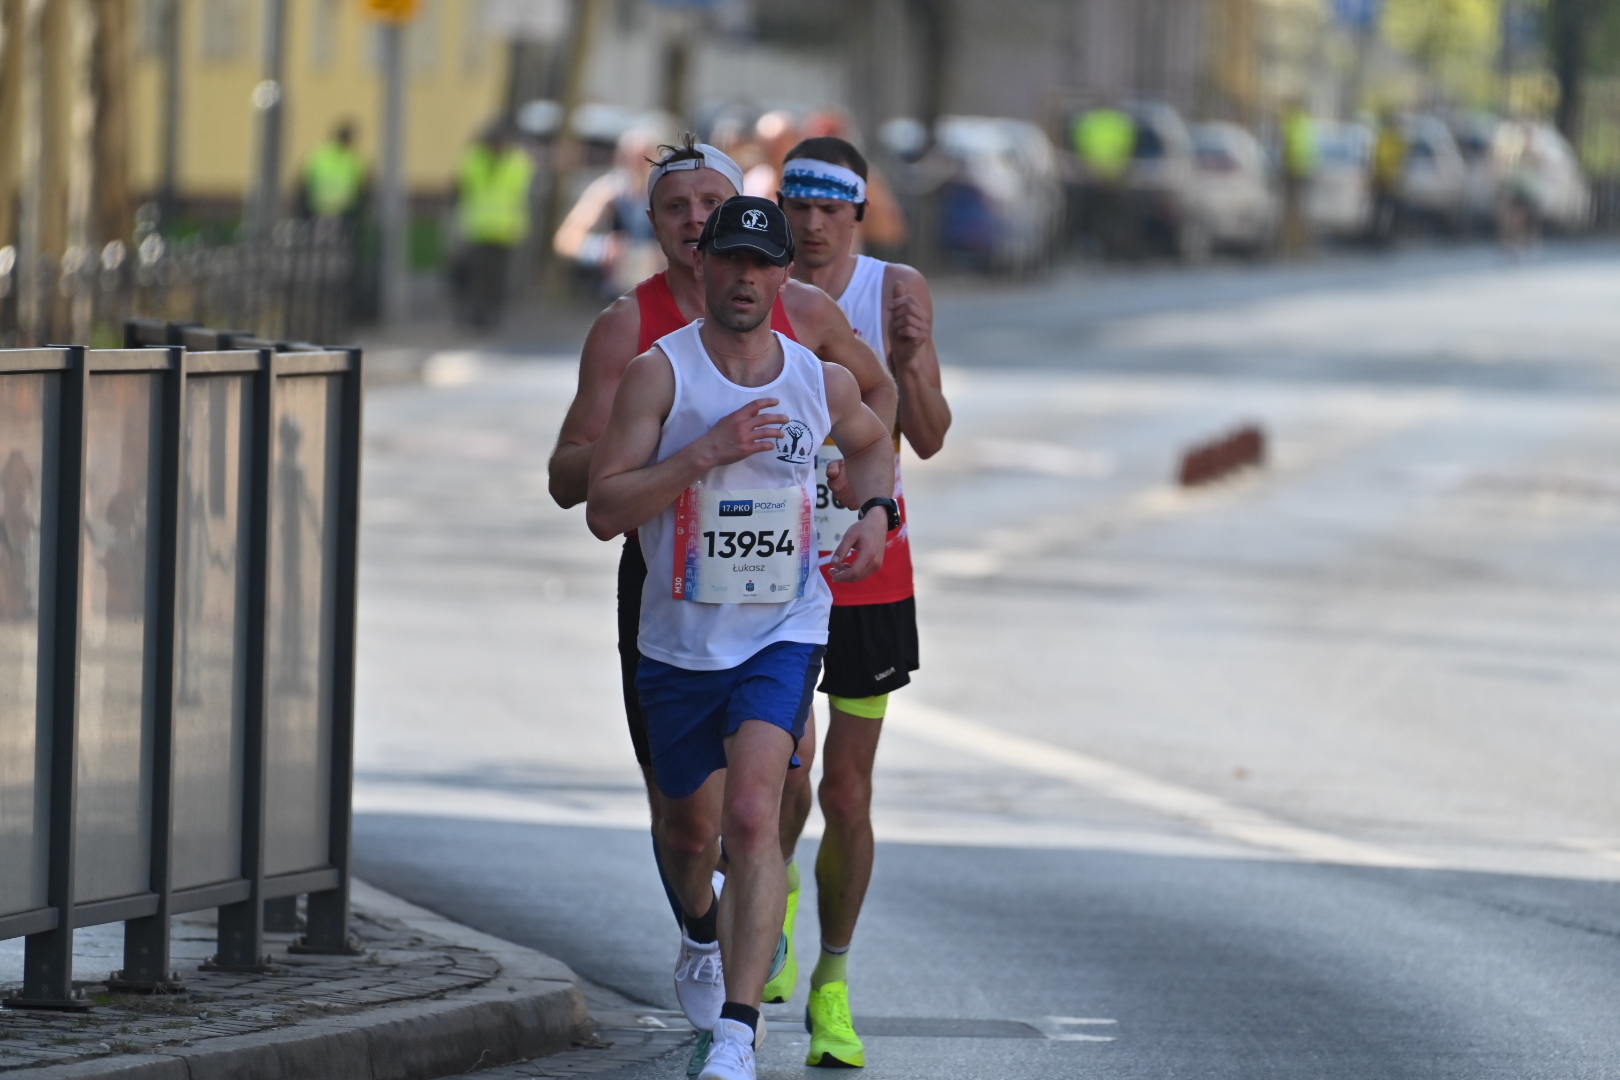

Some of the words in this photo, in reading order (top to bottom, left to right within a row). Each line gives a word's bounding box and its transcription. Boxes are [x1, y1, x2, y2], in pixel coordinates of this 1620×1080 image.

[722, 504, 750, 513] 17.PKO
[703, 530, 794, 559] 13954
[732, 563, 766, 573] Łukasz
[674, 577, 682, 594] M30
